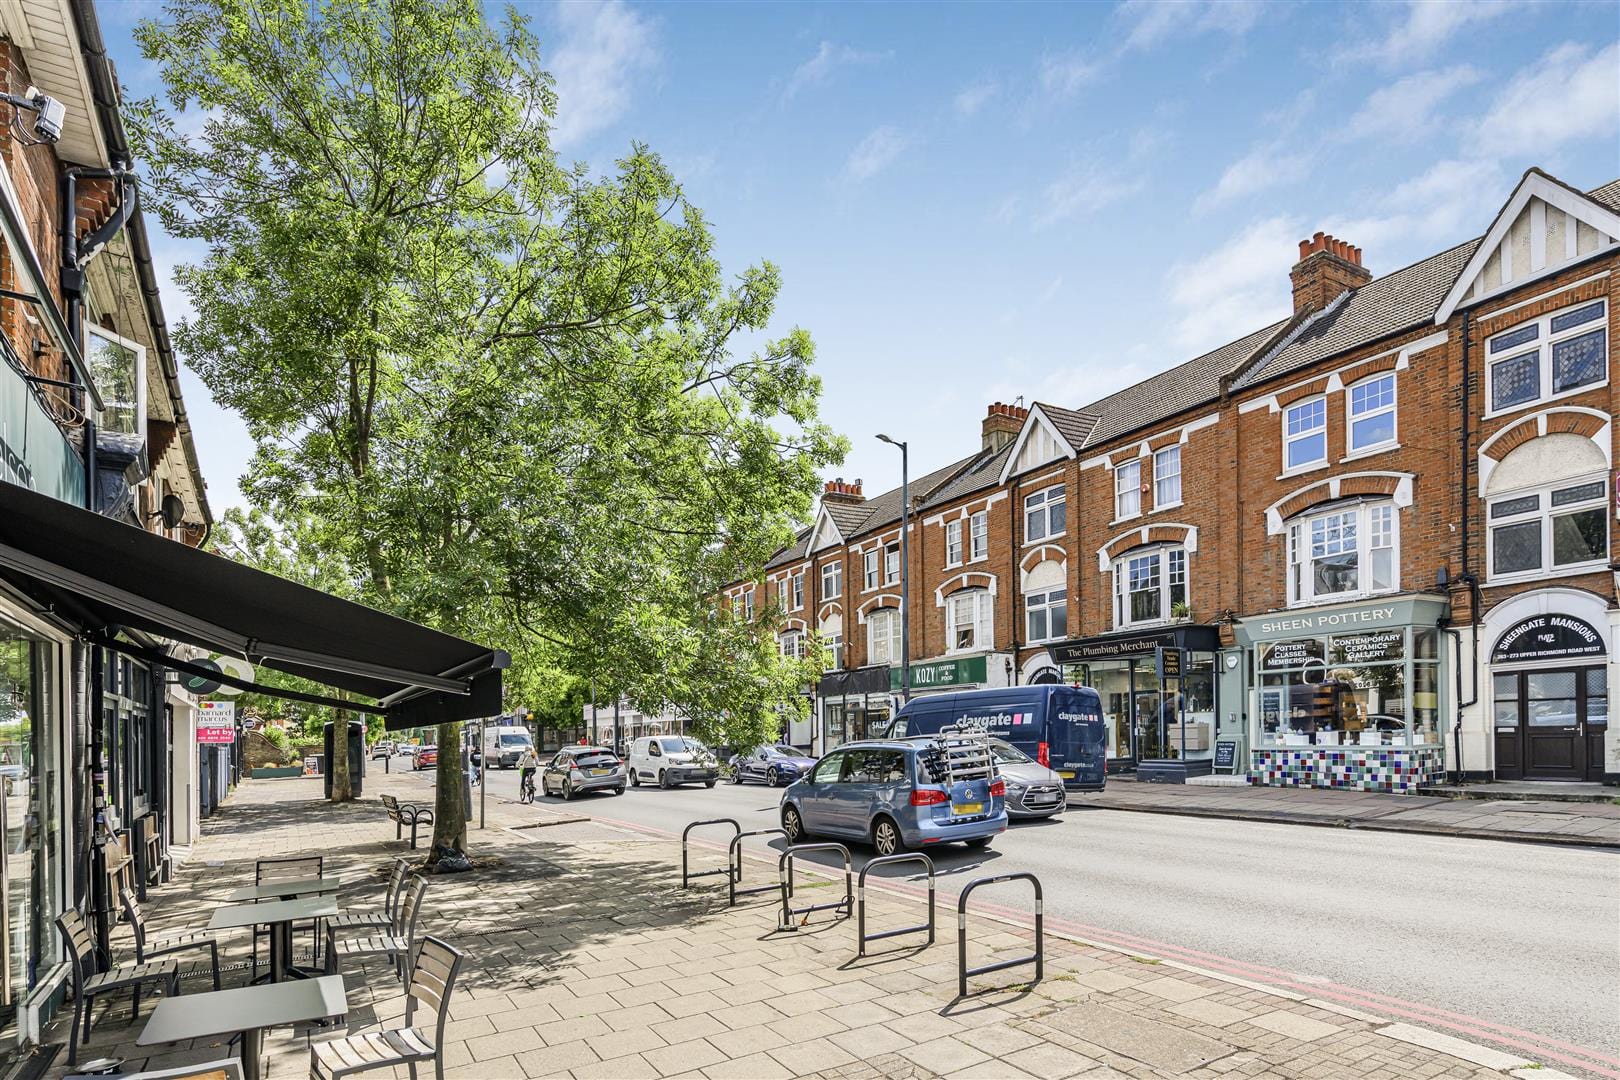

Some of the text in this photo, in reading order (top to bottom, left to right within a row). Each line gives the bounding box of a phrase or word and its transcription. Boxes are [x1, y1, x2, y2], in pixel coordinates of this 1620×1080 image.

[1262, 608, 1395, 633] SHEEN POTTERY
[1499, 617, 1597, 650] SHEENGATE MANSIONS
[1333, 633, 1401, 647] CONTEMPORARY
[1067, 640, 1159, 657] The Plumbing Merchant
[1274, 644, 1306, 652] POTTERY
[1345, 642, 1388, 652] CERAMICS
[1274, 650, 1307, 658] CLASSES
[1348, 650, 1385, 659] GALLERY
[1267, 656, 1315, 666] MEMBERSHIP
[915, 667, 935, 684] KOZY
[956, 713, 1012, 730] claygate
[1058, 711, 1089, 722] claygate
